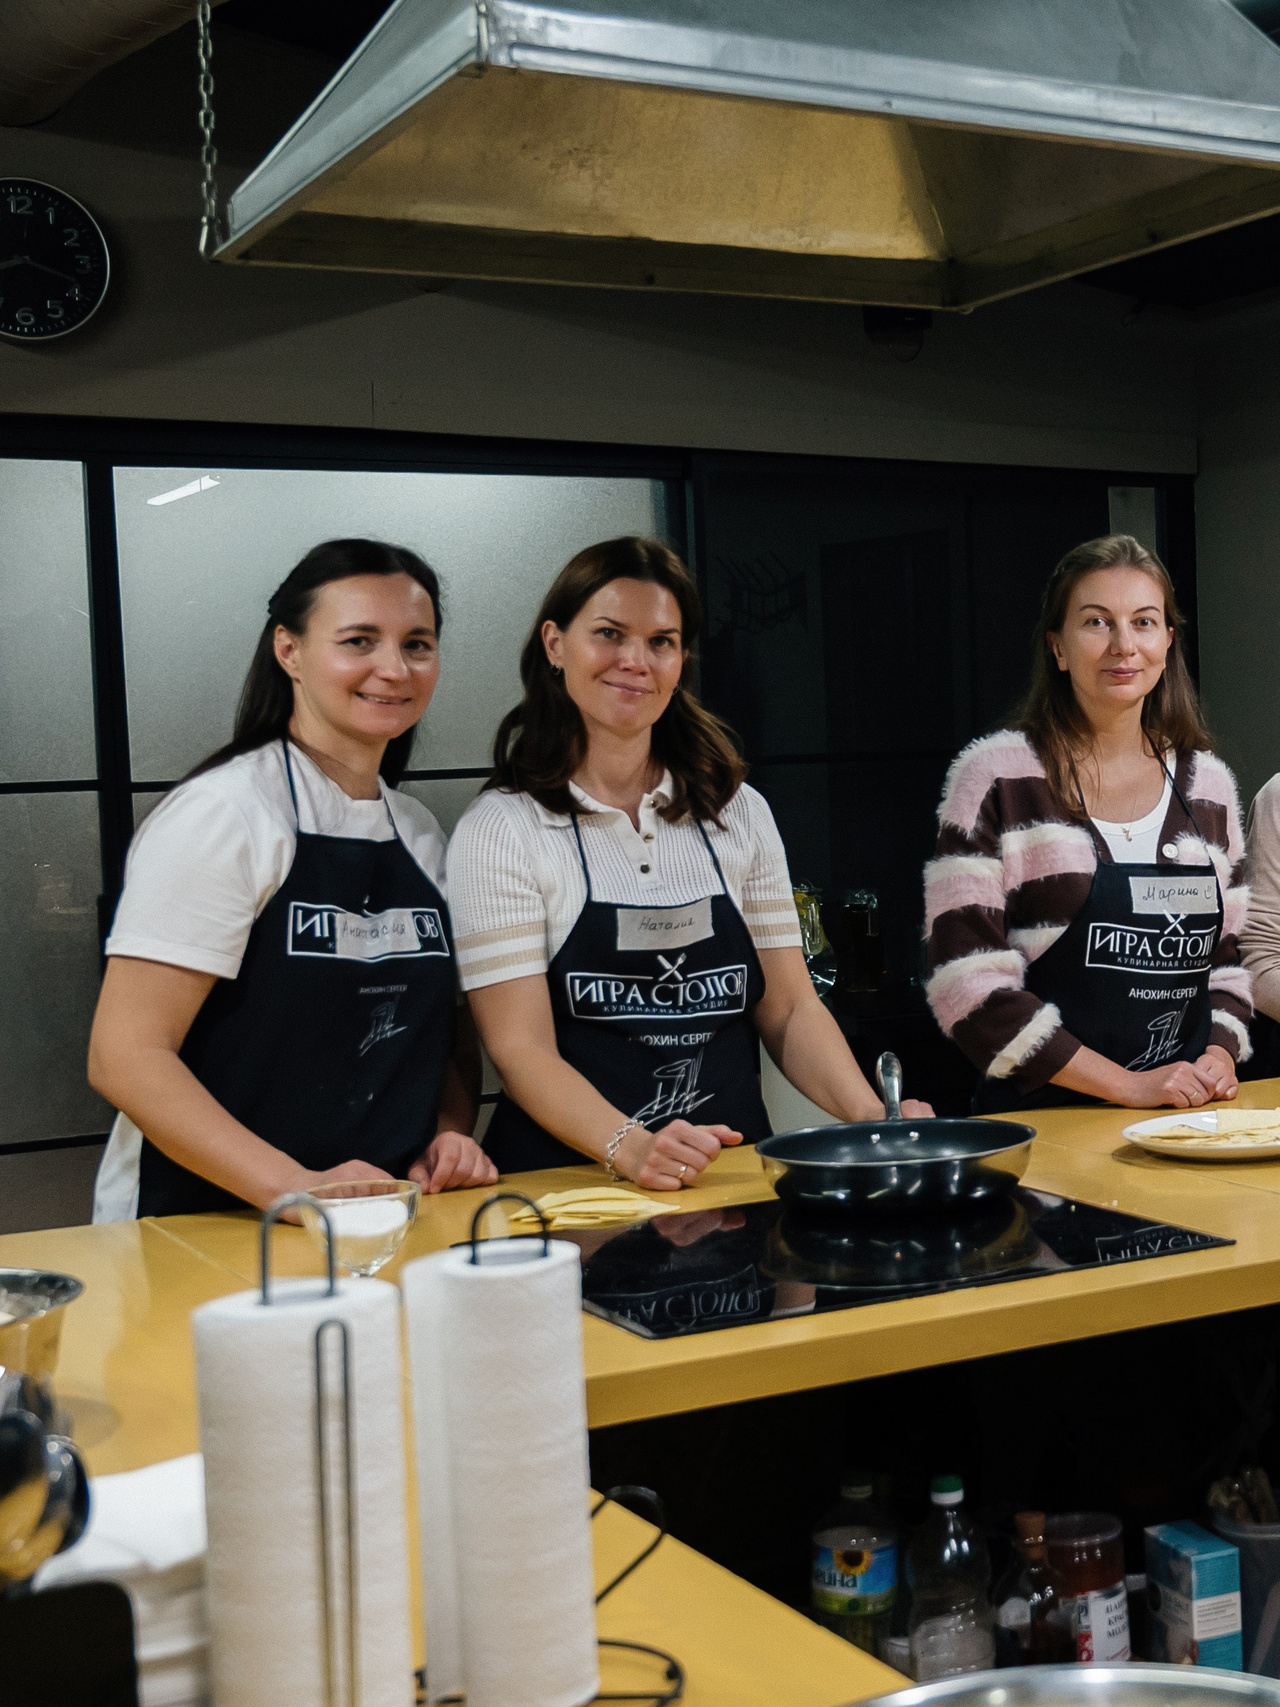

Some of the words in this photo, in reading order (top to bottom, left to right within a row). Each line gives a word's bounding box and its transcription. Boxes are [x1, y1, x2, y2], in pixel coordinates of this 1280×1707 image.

[6, 195, 34, 214] 12
[45, 207, 56, 225] 1
[63, 228, 81, 247] 2
[74, 254, 93, 274] 3
[15, 307, 36, 325] 6
[46, 299, 65, 319] 5
[1142, 885, 1199, 903] Марина
[297, 909, 337, 938] ИГ
[1095, 929, 1153, 957] ИГРА
[1158, 932, 1213, 958] СТОЛ
[1116, 956, 1179, 968] КУЛИНАРНАЯ
[574, 978, 646, 1006] ИГРА
[1128, 987, 1171, 1000] АНОХИН
